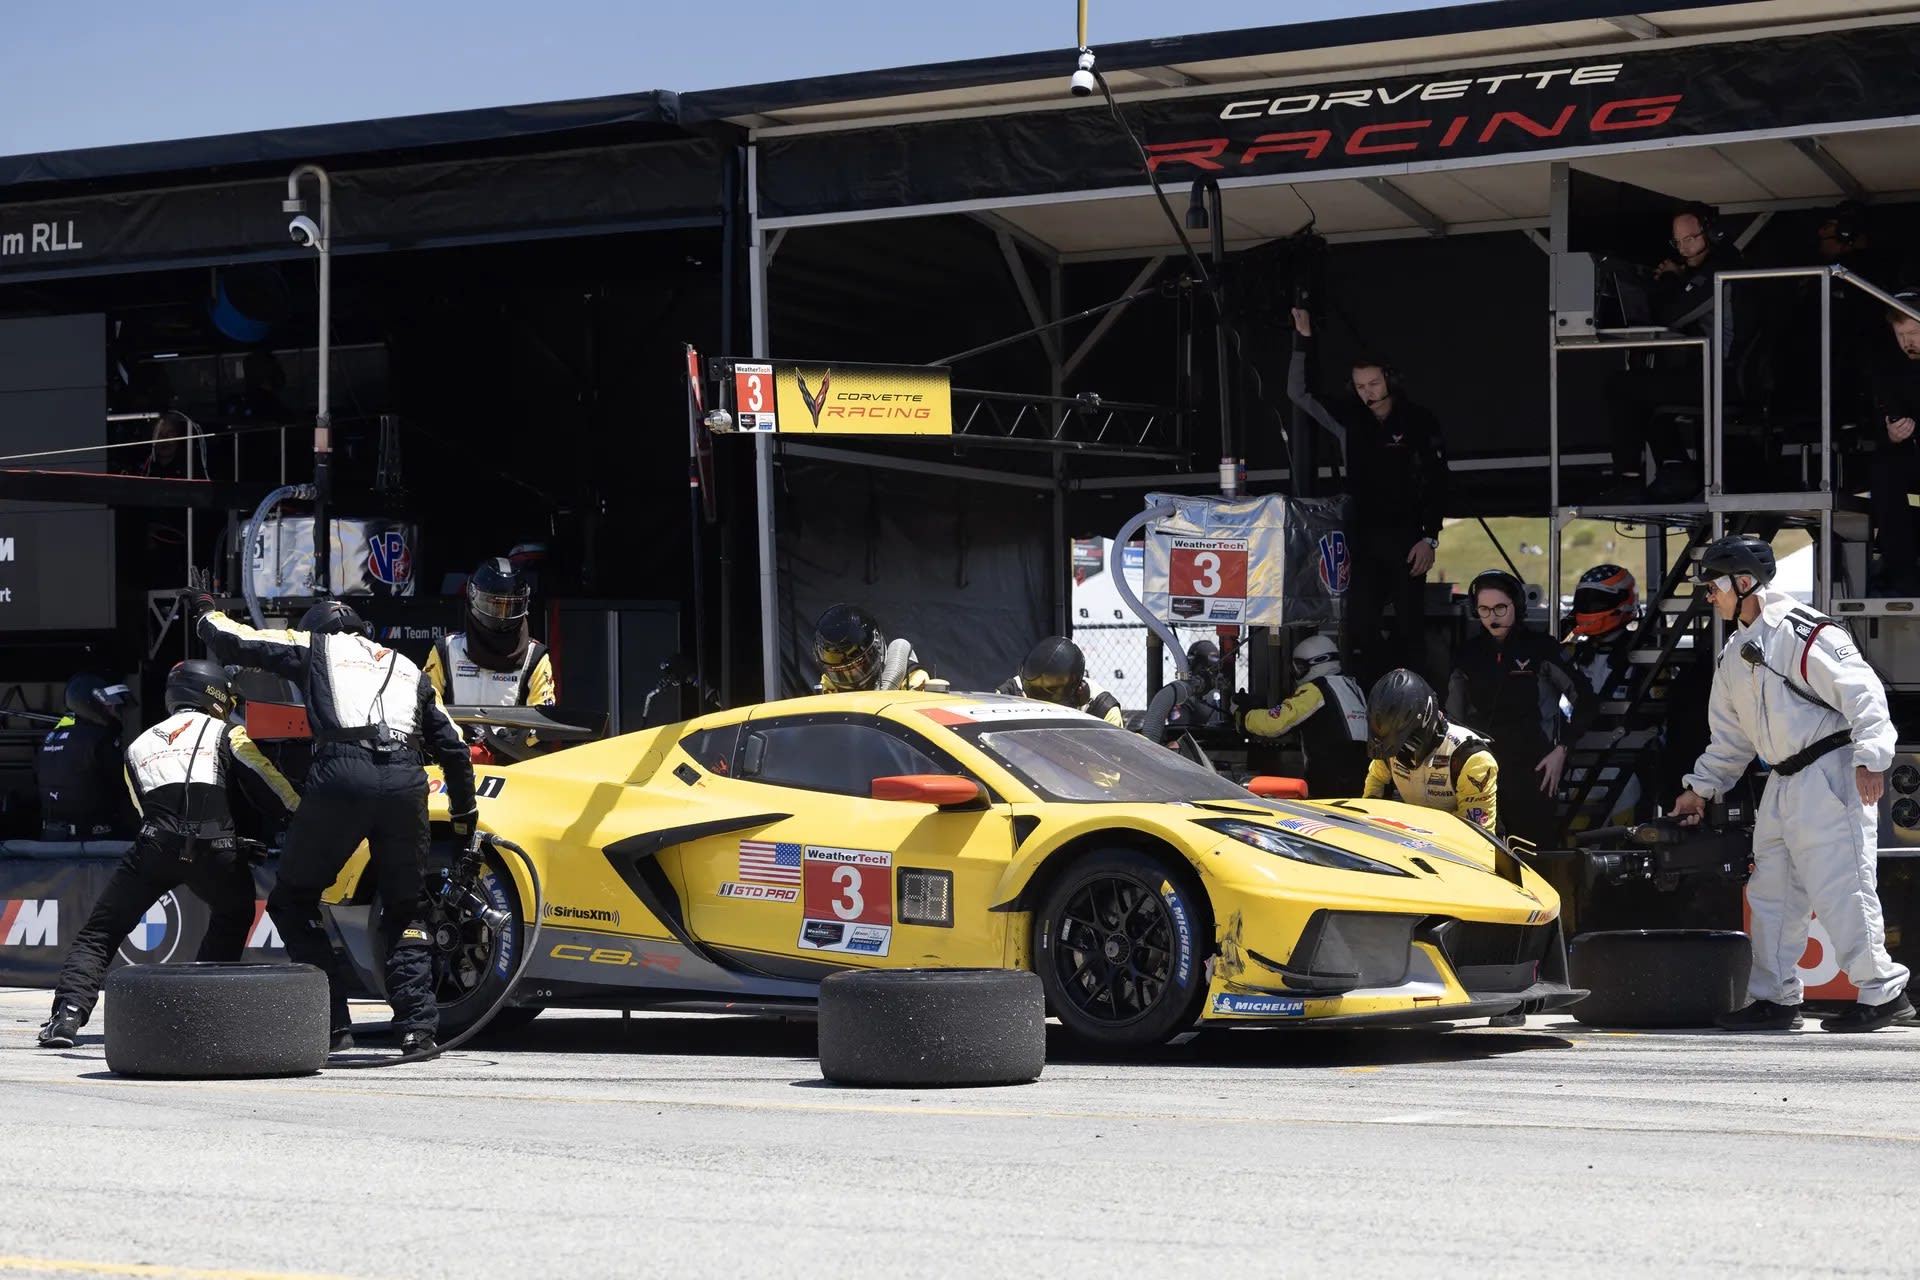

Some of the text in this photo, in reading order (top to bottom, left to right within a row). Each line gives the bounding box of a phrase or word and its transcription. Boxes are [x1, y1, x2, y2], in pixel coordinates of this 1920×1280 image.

[1220, 63, 1624, 120] CORVETTE
[1142, 94, 1684, 174] RACING
[32, 221, 82, 252] RLL
[748, 375, 763, 412] 3
[837, 393, 924, 402] CORVETTE
[827, 406, 931, 419] RACING
[1174, 540, 1245, 550] WeatherTech
[1193, 552, 1222, 596] 3
[404, 626, 429, 639] Team
[807, 849, 888, 865] WeatherTech
[733, 886, 797, 900] GTD PRO
[831, 865, 864, 920] 3
[1173, 906, 1190, 981] MICHELIN
[550, 944, 682, 972] C8.R
[1234, 1001, 1303, 1011] MICHELIN
